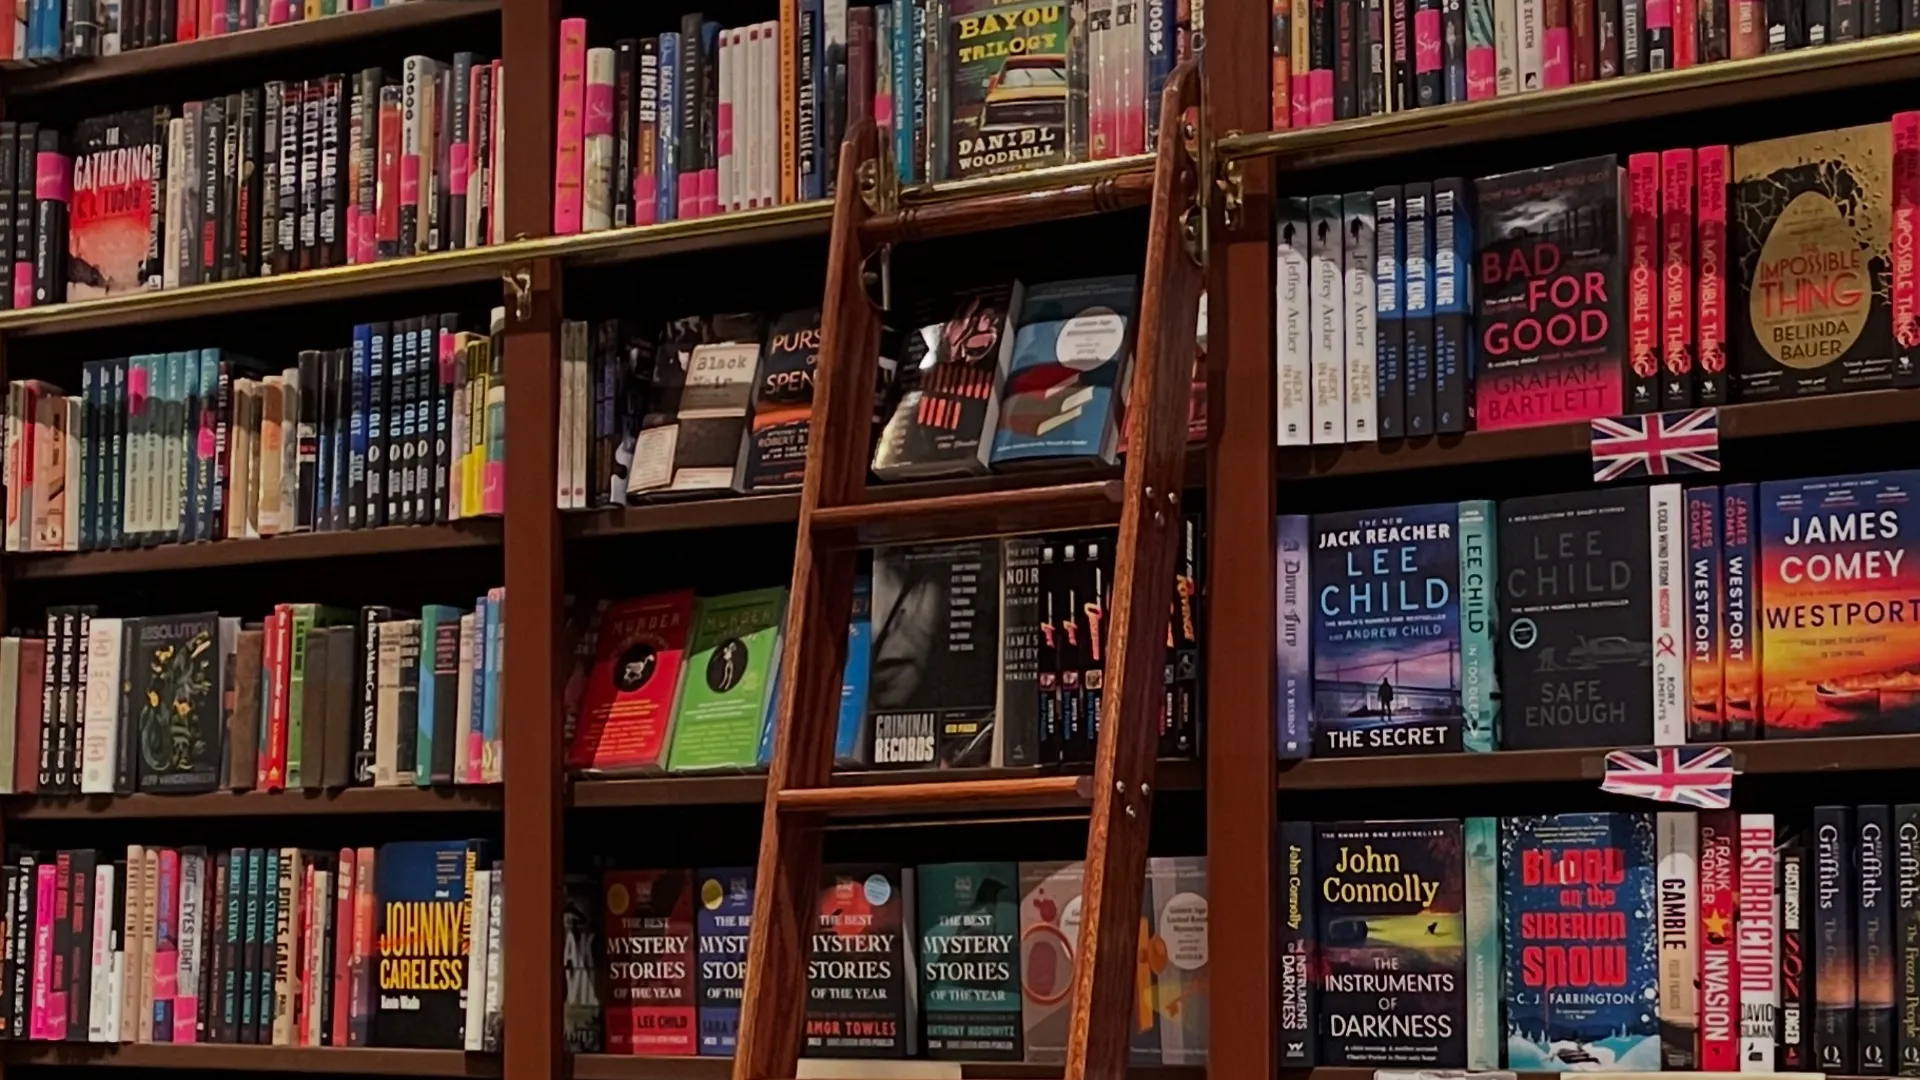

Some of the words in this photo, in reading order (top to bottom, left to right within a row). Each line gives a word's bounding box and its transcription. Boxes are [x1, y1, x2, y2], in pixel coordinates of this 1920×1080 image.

[959, 6, 1060, 40] BAYOU
[958, 33, 1058, 64] TRILOGY
[641, 54, 657, 121] RINGER
[958, 128, 1055, 156] DANIEL
[74, 143, 152, 193] GATHERING
[958, 145, 1055, 171] WOODRELL
[1378, 198, 1394, 221] THE
[1378, 223, 1394, 281] MIDNIGHT
[1481, 243, 1561, 285] BAD
[1898, 206, 1914, 291] IMPOSSIBLE
[1352, 251, 1368, 297] Jeffrey
[1760, 250, 1861, 279] IMPOSSIBLE
[1285, 260, 1300, 303] Jeffrey
[1528, 271, 1608, 313] FOR
[1759, 273, 1865, 319] THING
[1378, 283, 1394, 312] KING
[1288, 306, 1301, 353] Archer
[1354, 301, 1368, 348] Archer
[1483, 309, 1608, 355] GOOD
[1773, 320, 1851, 343] BELINDA
[1897, 293, 1915, 347] THING
[371, 336, 383, 360] OUT
[695, 355, 747, 372] Black
[1780, 339, 1843, 360] BAUER
[1493, 362, 1600, 397] GRAHAM
[1488, 386, 1608, 423] BARTLETT
[369, 406, 380, 438] COLD
[1319, 530, 1361, 549] JACK
[1366, 523, 1451, 545] REACHER
[1359, 519, 1376, 528] THE
[1381, 516, 1404, 526] NEW
[1690, 500, 1701, 550] COMEY
[1702, 502, 1713, 548] JAMES
[1784, 510, 1899, 545] JAMES
[1466, 534, 1482, 569] LEE
[1534, 530, 1603, 561] LEE
[1006, 567, 1039, 584] NOIR
[1347, 546, 1418, 577] LEE
[1780, 549, 1905, 584] COMEY
[1507, 560, 1632, 598] CHILD
[1320, 577, 1450, 616] CHILD
[1467, 573, 1484, 633] CHILD
[1695, 559, 1709, 663] WESTPORT
[1729, 556, 1743, 661] WESTPORT
[47, 614, 57, 636] And
[612, 614, 680, 635] MURDER
[1766, 598, 1920, 630] WESTPORT
[1005, 634, 1039, 646] JAMES
[1345, 627, 1398, 640] ANDREW
[1402, 623, 1442, 637] CHILD
[45, 653, 55, 683] Shall
[1005, 648, 1039, 660] ELLROY
[42, 683, 54, 724] Appear
[1541, 680, 1602, 703] SAFE
[1656, 663, 1666, 721] CLEMENTS
[1667, 676, 1676, 705] RORY
[875, 713, 935, 737] CRIMINAL
[1525, 702, 1625, 727] ENOUGH
[874, 736, 935, 763] RECORDS
[1327, 730, 1364, 749] THE
[1369, 726, 1449, 748] SECRET
[280, 854, 293, 881] THE
[1289, 845, 1301, 876] John
[1336, 845, 1400, 873] John
[1522, 849, 1625, 886] BLOOD
[1701, 827, 1715, 904] GARDNER
[1715, 836, 1731, 891] FRANK
[1819, 824, 1840, 909] Griffiths
[1862, 823, 1882, 908] Griffiths
[1899, 822, 1920, 908] Griffiths
[128, 859, 139, 895] DEVIL
[1323, 874, 1440, 907] Connolly
[278, 887, 291, 936] POET'S
[1288, 878, 1302, 930] Connolly
[1740, 828, 1774, 991] RESURRECTION
[1785, 862, 1800, 930] GUSTAWSSON
[183, 902, 196, 935] EYES
[228, 899, 239, 944] STATION
[380, 902, 465, 957] JOHNNY
[644, 917, 670, 928] BEST
[820, 915, 842, 926] THE
[844, 914, 873, 925] BEST
[940, 915, 960, 926] THE
[963, 915, 993, 926] BEST
[1521, 912, 1627, 940] SIBERIAN
[1662, 879, 1687, 950] GAMBLE
[607, 936, 688, 955] MYSTERY
[924, 935, 1013, 954] MYSTERY
[1907, 925, 1917, 943] The
[180, 937, 195, 973] TIGHT
[276, 943, 289, 984] GAME
[610, 961, 686, 980] STORIES
[808, 961, 892, 980] STORIES
[1373, 957, 1399, 970] THE
[1905, 946, 1919, 993] Frozen
[380, 959, 463, 990] CARELESS
[926, 962, 1010, 981] STORIES
[1325, 974, 1454, 993] INSTRUMENTS
[707, 988, 721, 998] OF
[811, 988, 828, 999] OF
[830, 988, 852, 999] THE
[855, 988, 888, 999] YEAR
[930, 990, 947, 1000] OF
[949, 990, 971, 1000] THE
[973, 990, 1006, 1001] YEAR
[1378, 998, 1397, 1010] OF
[1549, 991, 1636, 1005] FARRINGTON
[1704, 950, 1729, 1041] INVASION
[637, 1016, 655, 1028] LEE
[658, 1015, 688, 1028] CHILD
[807, 1021, 841, 1036] AMOR
[845, 1021, 897, 1037] TOWLES
[927, 1025, 964, 1037] ANTHONY
[967, 1025, 1015, 1037] HOROWITZ
[1330, 1015, 1452, 1037] DARKNESS
[1785, 1008, 1800, 1045] ENGER
[1902, 995, 1919, 1038] People
